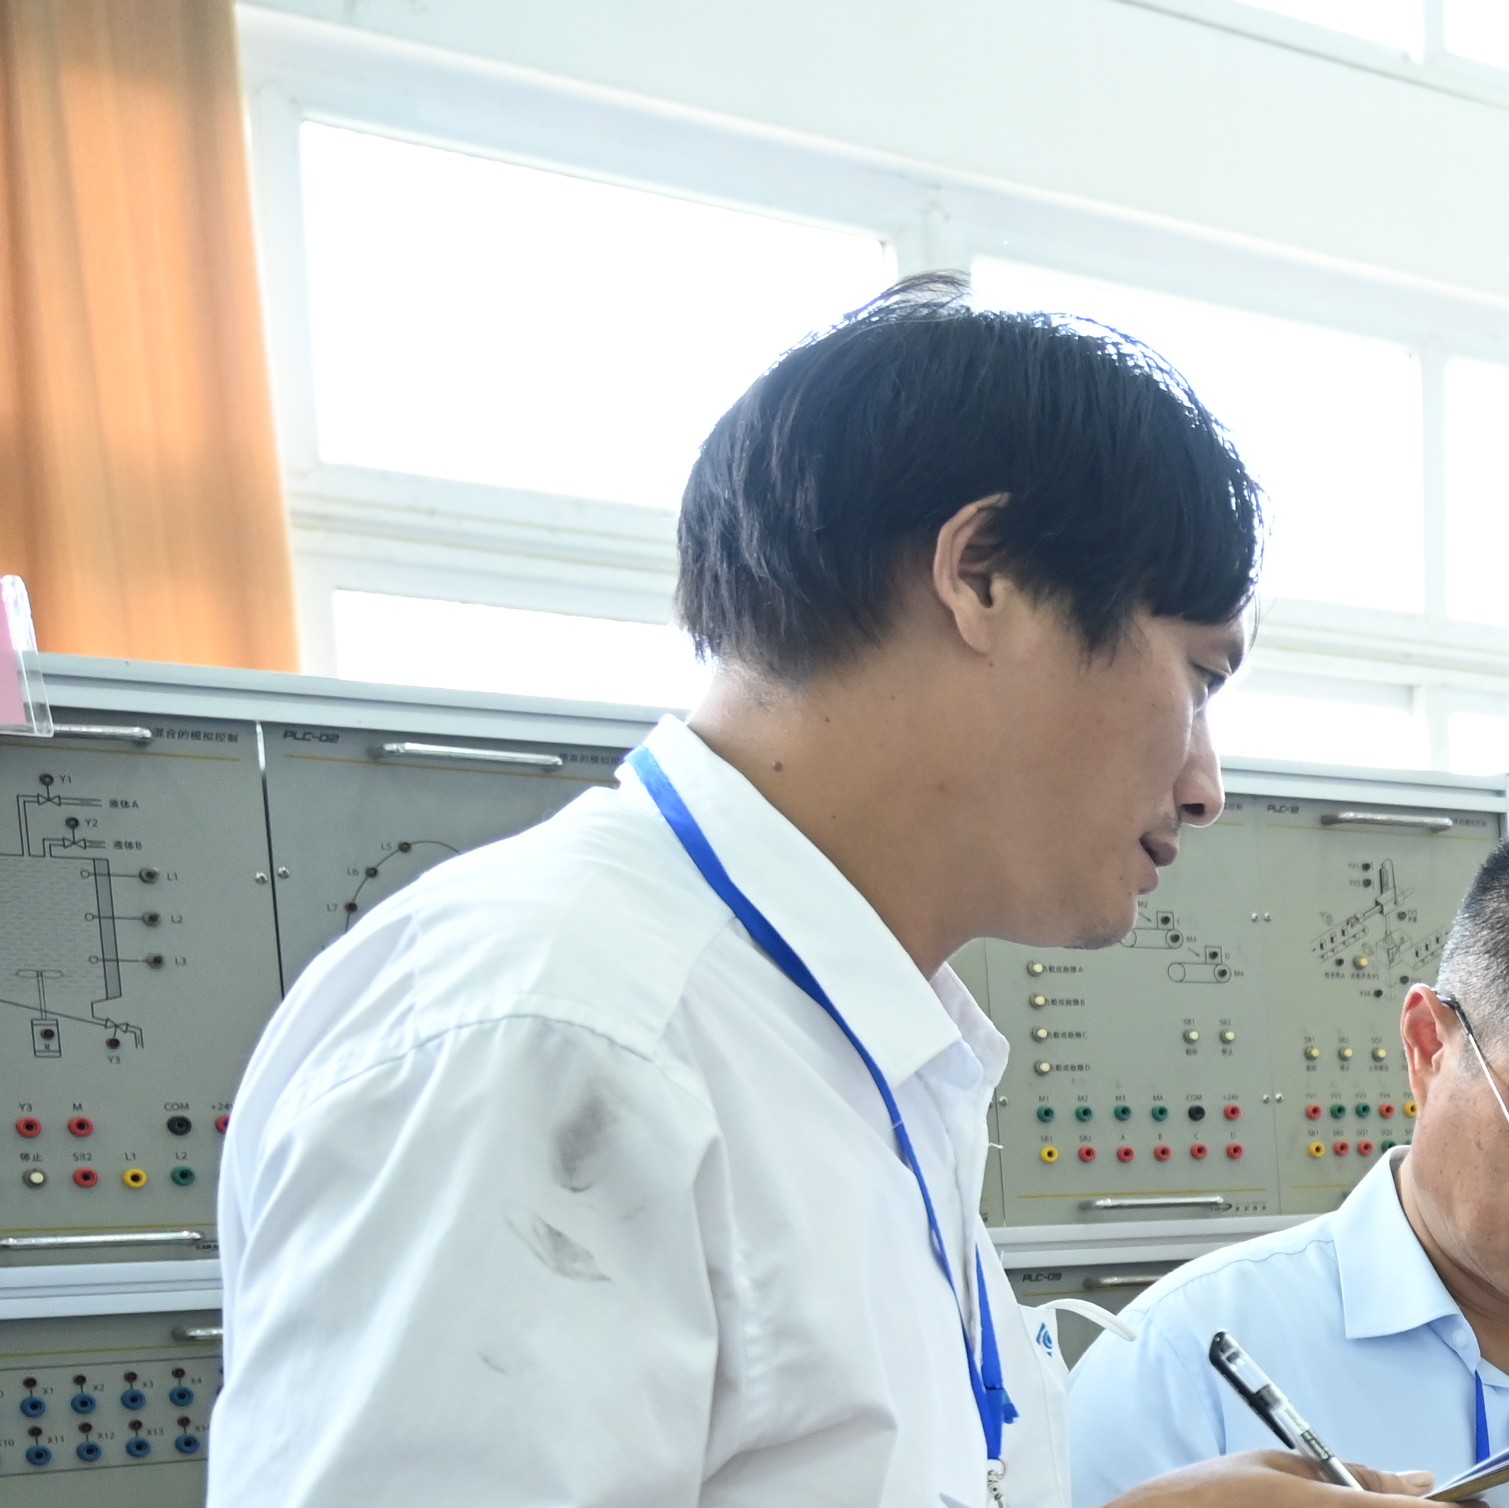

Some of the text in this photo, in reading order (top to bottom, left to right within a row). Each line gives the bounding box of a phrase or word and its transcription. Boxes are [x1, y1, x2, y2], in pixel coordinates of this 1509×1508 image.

[283, 728, 340, 744] PLC-02
[59, 775, 72, 784] Y1
[85, 818, 98, 827] Y2
[19, 1102, 33, 1112] Y3
[164, 1102, 190, 1112] COM
